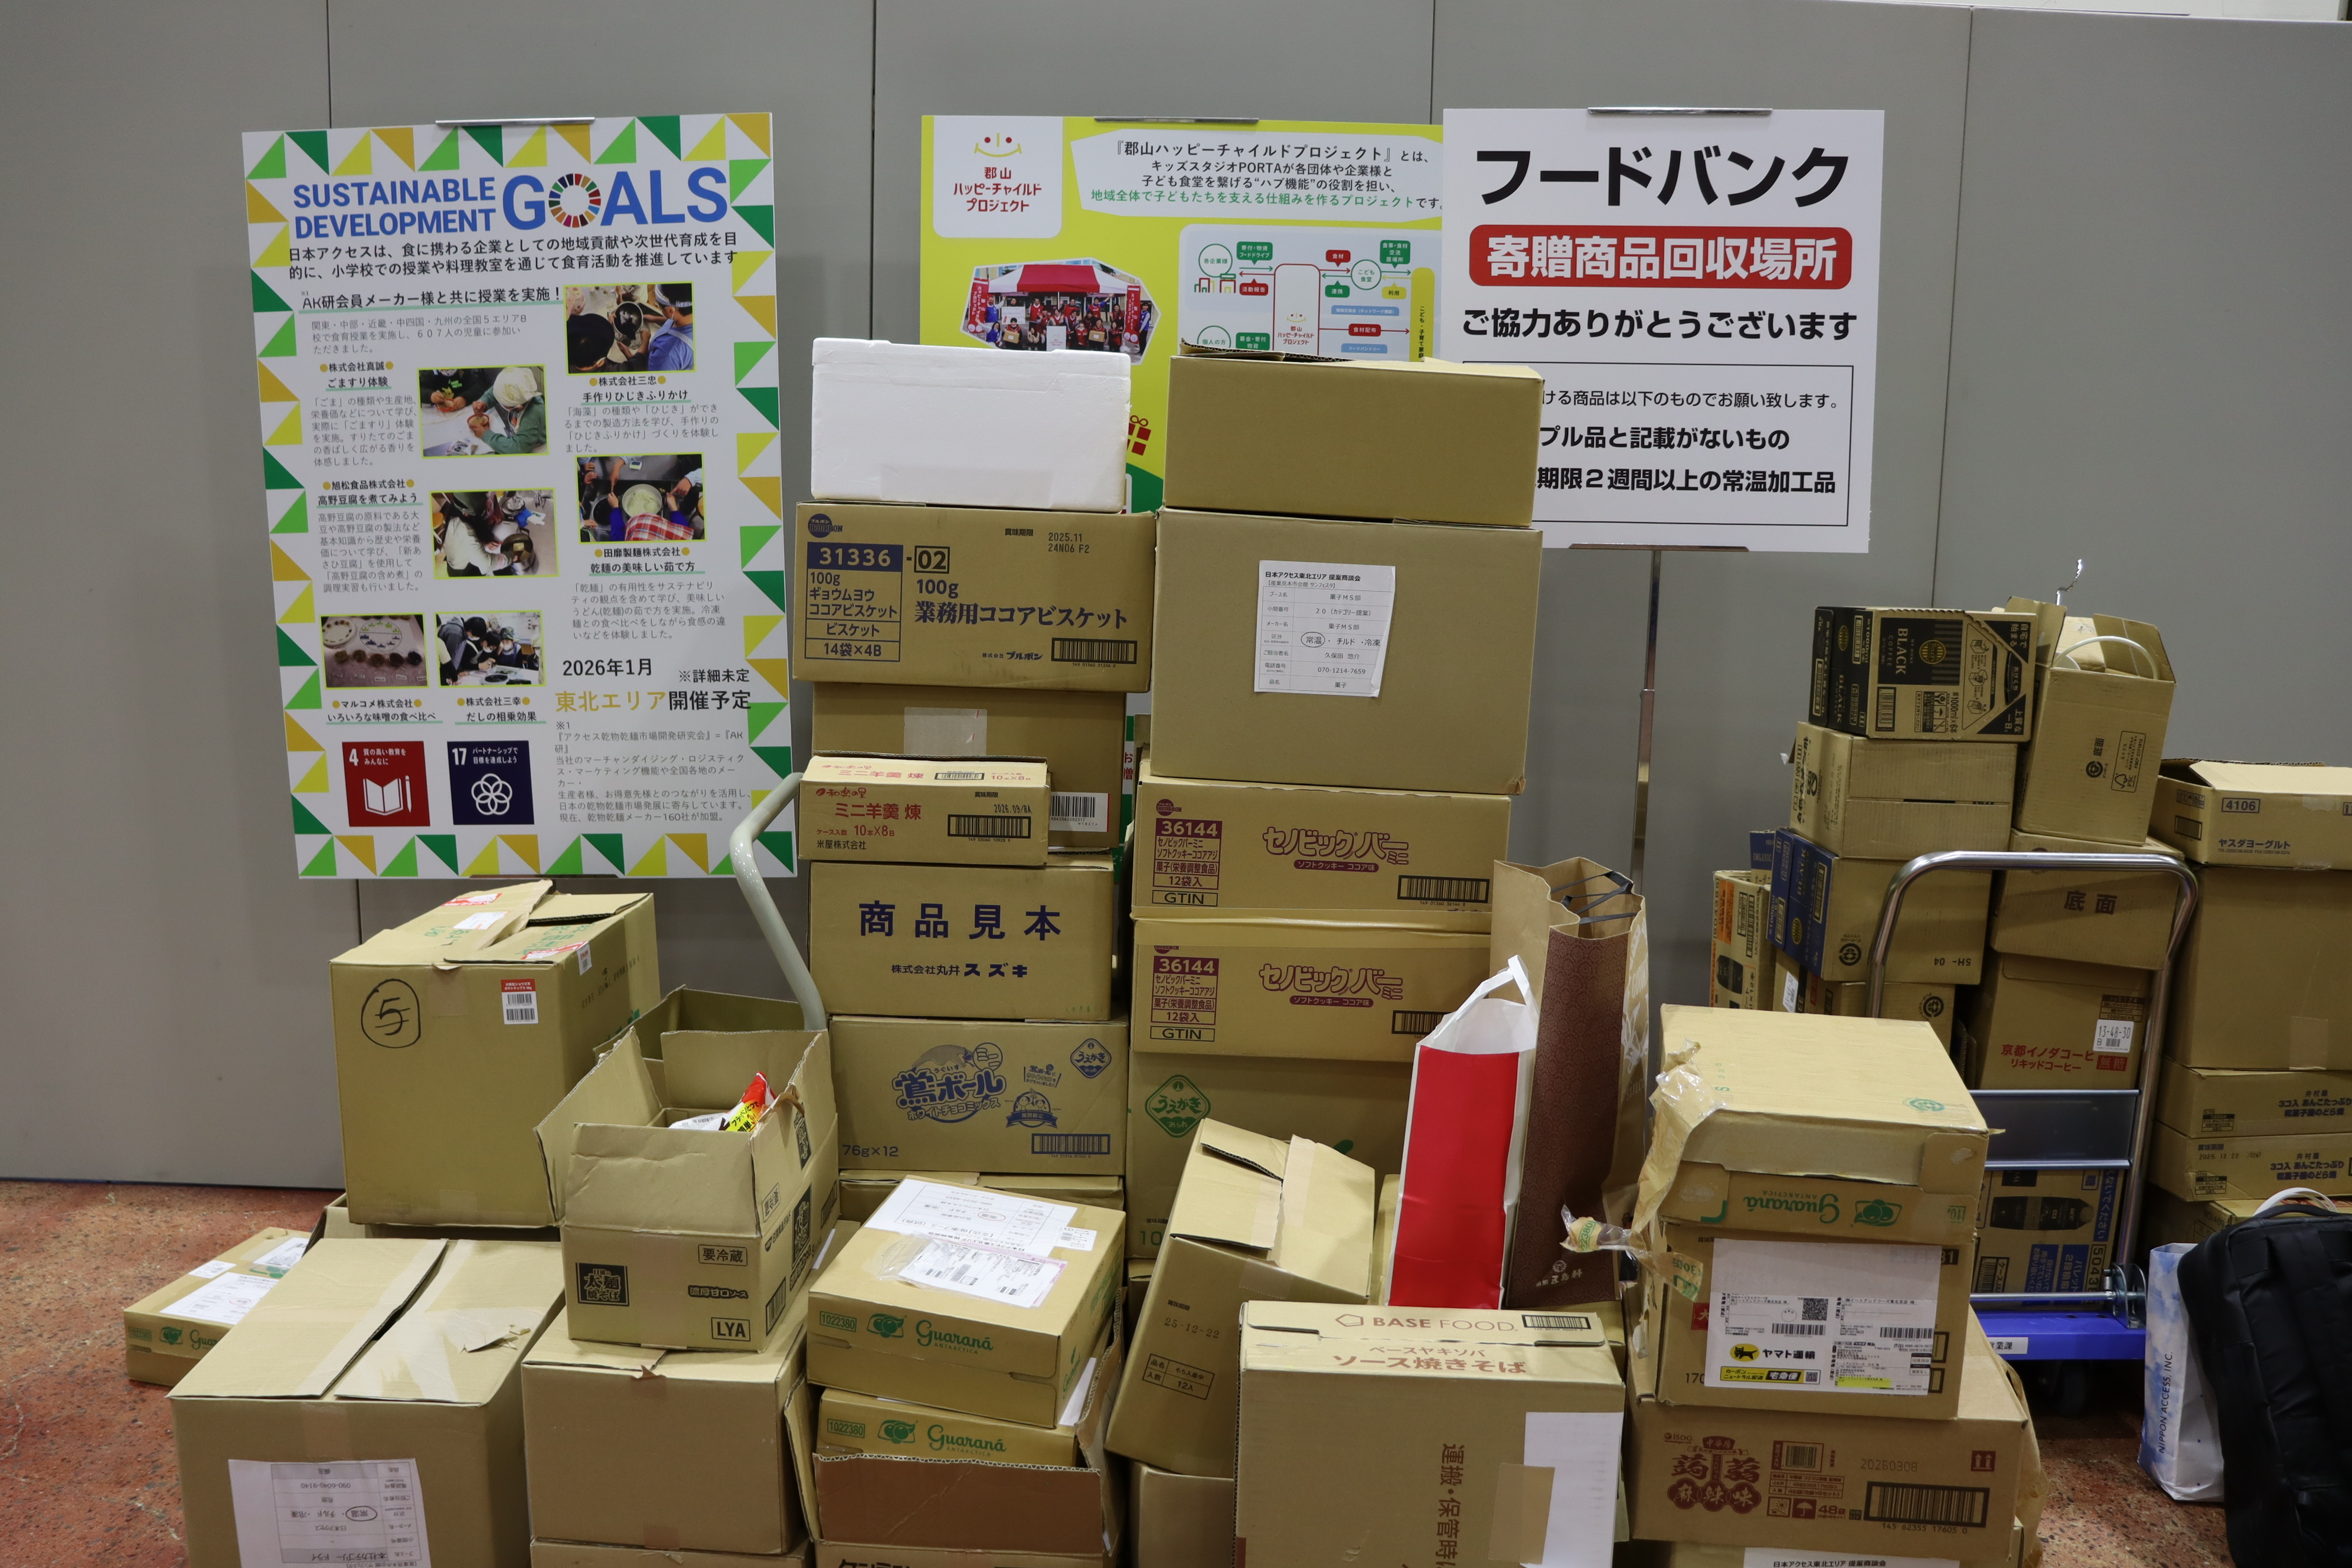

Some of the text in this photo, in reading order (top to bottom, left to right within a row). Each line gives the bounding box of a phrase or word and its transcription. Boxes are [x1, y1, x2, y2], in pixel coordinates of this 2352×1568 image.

[984, 167, 1011, 179] 郡山
[1151, 160, 1393, 178] キッズスタジオPORTAが各団体や企業様と
[1477, 145, 1849, 207] フードバンク
[293, 177, 496, 209] SUSTAINABLE
[953, 183, 1041, 196] ハッピーチャイルド
[966, 198, 1030, 212] プロジェクト
[295, 208, 496, 239] DEVELOPMENT
[289, 231, 737, 262] 日本アクセスは、食に携わる企業としての地域貢献や次世代育成を目
[1487, 235, 1837, 281] 寄贈商品回収場所
[289, 250, 737, 280] 的に、小学校での授業や料理教室を通じて食育活動を推進しています
[1463, 308, 1857, 340] ご協力ありがとうございます
[313, 344, 374, 354] ただきました。
[328, 377, 388, 388] ごますり体験
[583, 390, 688, 403] 手作りひじきふりかけ
[311, 407, 417, 419] 栄養価などについて学び、
[564, 416, 718, 429] るまでの製造方法を学び、手作りの
[313, 431, 414, 442] を実施。すりたてのごま
[567, 428, 718, 440] 「ひじきふりかけ」づくりを体験し
[1540, 426, 1789, 450] プル品と記載がないもの
[313, 443, 414, 455] の香ばしく広がる香りを
[566, 443, 598, 453] ました。
[314, 456, 374, 467] 体感しました。
[332, 479, 405, 490] 旭松食品株式会社
[1536, 467, 1835, 494] 期限２週間以上の常温加工品
[318, 494, 417, 505] 高野豆腐を煮てみよう
[318, 511, 419, 522] 高野豆腐の原料である大
[320, 535, 421, 545] 基本知識から歴史や栄養
[1048, 533, 1083, 542] 2025.11
[1079, 544, 1089, 554] F2
[819, 548, 891, 566] 31336
[590, 561, 695, 573] 乾麺の美味しい茹で方
[810, 572, 840, 586] 100g
[1266, 571, 1327, 580] 日本アクセス東北エリア
[809, 588, 875, 601] ギョウムヨウ
[916, 579, 959, 599] 100g
[809, 602, 898, 617] ココアビスケット
[914, 601, 1126, 629] 業務用ココアビスケット
[573, 629, 673, 640] いなどを体験しました。
[827, 623, 879, 636] ビスケット
[2020, 624, 2028, 648] 自宅で
[1895, 628, 1908, 675] BLACK
[563, 658, 652, 677] 2026年1月
[679, 669, 750, 683] ※詳細未定
[341, 698, 413, 708] マルコメ株式会社
[556, 690, 751, 712] 東北エリア開催予定
[328, 713, 436, 722] いろいろな味噌の食べ比べ
[467, 711, 537, 722] だしの相乗効果
[349, 749, 358, 766] 4
[363, 748, 406, 756] 質の高い教育を
[452, 747, 466, 766] 17
[364, 757, 388, 766] みんなに
[473, 756, 517, 765] 目標を達成しよう
[835, 803, 922, 820] ミニ羊羹 煉
[2226, 801, 2256, 811] 4106
[1161, 821, 1217, 837] 36144
[816, 840, 867, 850] 米屋株式会社
[1157, 838, 1204, 848] セノビックバーミニ
[2219, 839, 2291, 849] ヤスダヨーグルト
[1157, 848, 1218, 860] ソフトクッキーココアアジ
[1298, 861, 1375, 871] ソフトクッキー ココア味
[1797, 848, 1807, 896] BLACK
[1168, 876, 1202, 887] 12袋入
[1164, 893, 1204, 904] GTIN
[2064, 890, 2118, 915] 底面
[859, 900, 1061, 941] 商品見本
[1158, 959, 1214, 974] 36144
[1155, 975, 1201, 985] セノビックバーミニ
[1155, 985, 1215, 997] ソフトクッキーココアアジ
[1294, 996, 1340, 1005] ソフトクッキー
[1167, 1012, 1200, 1023] 12袋入
[1162, 1028, 1202, 1040] GTIN
[2099, 1025, 2131, 1039] 13-48-30
[1074, 1051, 1106, 1063] うえがき
[2001, 1044, 2095, 1061] 京都イノダコーヒ
[2011, 1059, 2081, 1072] リキッドコーヒー
[907, 1097, 1001, 1121] ホワイトチョコミックス
[1152, 1095, 1203, 1115] うえがき
[1743, 1193, 1840, 1224] Guaraná
[703, 1247, 743, 1263] 要冷蔵
[689, 1286, 749, 1298] 濃厚甘口ソース
[821, 1313, 856, 1330] 1022380
[1164, 1317, 1220, 1339] 25-12-22
[1373, 1317, 1432, 1329] BASE
[717, 1321, 746, 1338] LYA
[915, 1319, 994, 1353] Guaraná
[934, 1342, 979, 1355] ANTARCTICA
[1368, 1345, 1487, 1358] ベースヤキソバ
[1762, 1349, 1815, 1360] ヤマト運輸
[1332, 1355, 1527, 1374] ソース焼きそば
[1769, 1372, 1798, 1380] 宅急便
[2158, 1352, 2173, 1453] NIPPON ACCESS, INC.
[828, 1420, 864, 1437] 1022380
[927, 1424, 1007, 1453] Guaraná
[946, 1446, 992, 1458] ANTARCTICA
